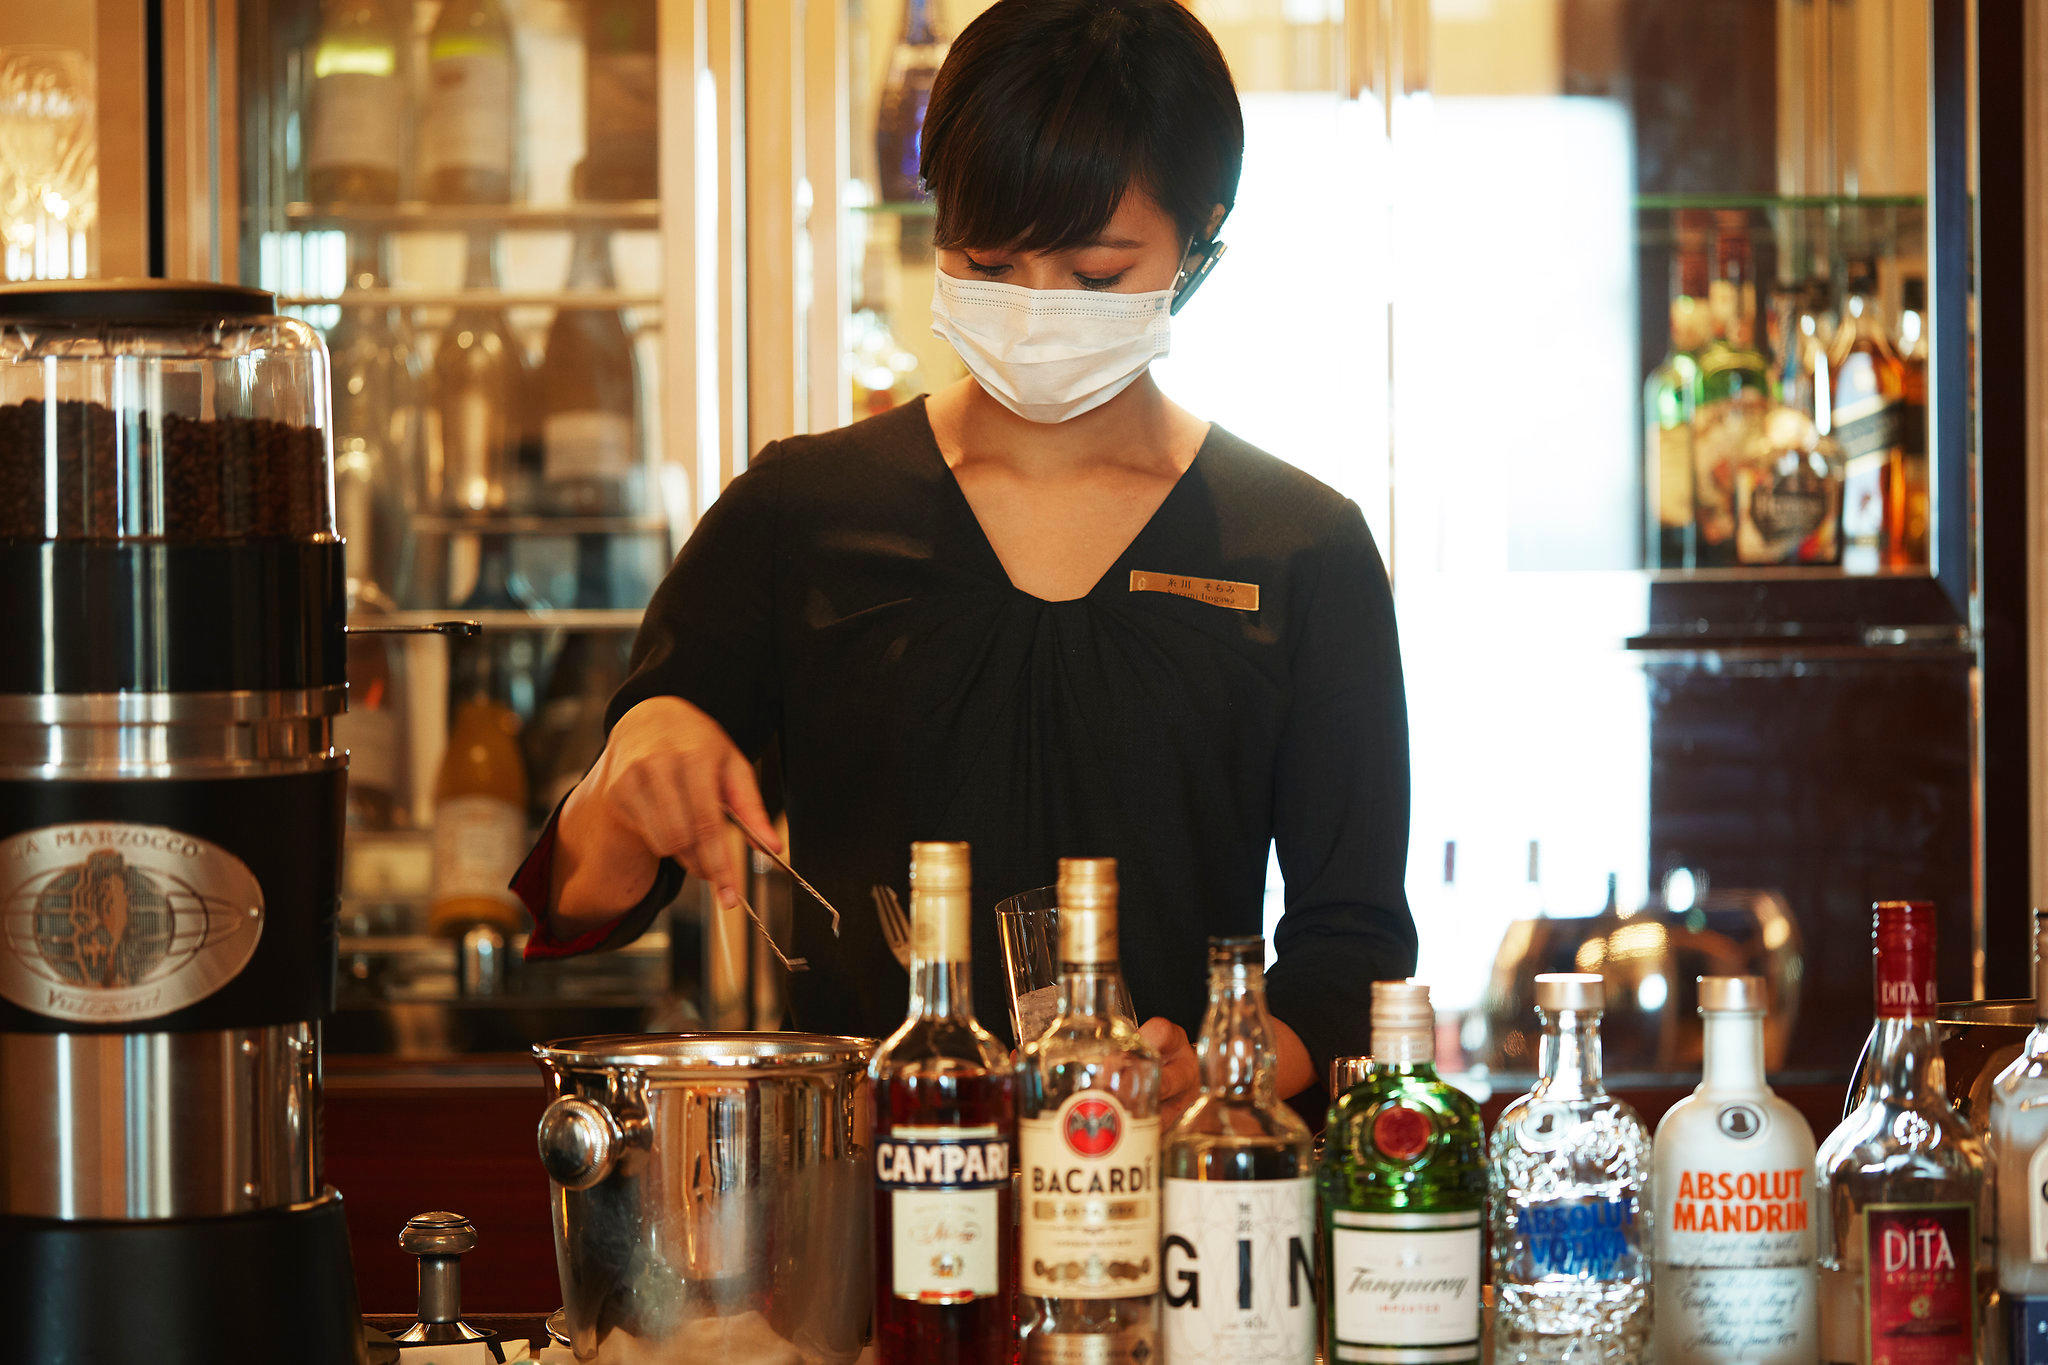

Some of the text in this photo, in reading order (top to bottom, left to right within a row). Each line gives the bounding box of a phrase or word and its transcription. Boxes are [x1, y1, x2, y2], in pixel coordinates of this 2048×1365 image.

[55, 828, 200, 858] MARZOCCO
[1881, 979, 1920, 1006] DITA
[876, 1141, 1010, 1184] CAMPARI
[1676, 1168, 1806, 1202] ABSOLUT
[1672, 1201, 1809, 1233] MANDRIN
[1884, 1228, 1956, 1273] DITA
[1162, 1234, 1317, 1310] GIN
[1346, 1265, 1470, 1301] Tanqueray
